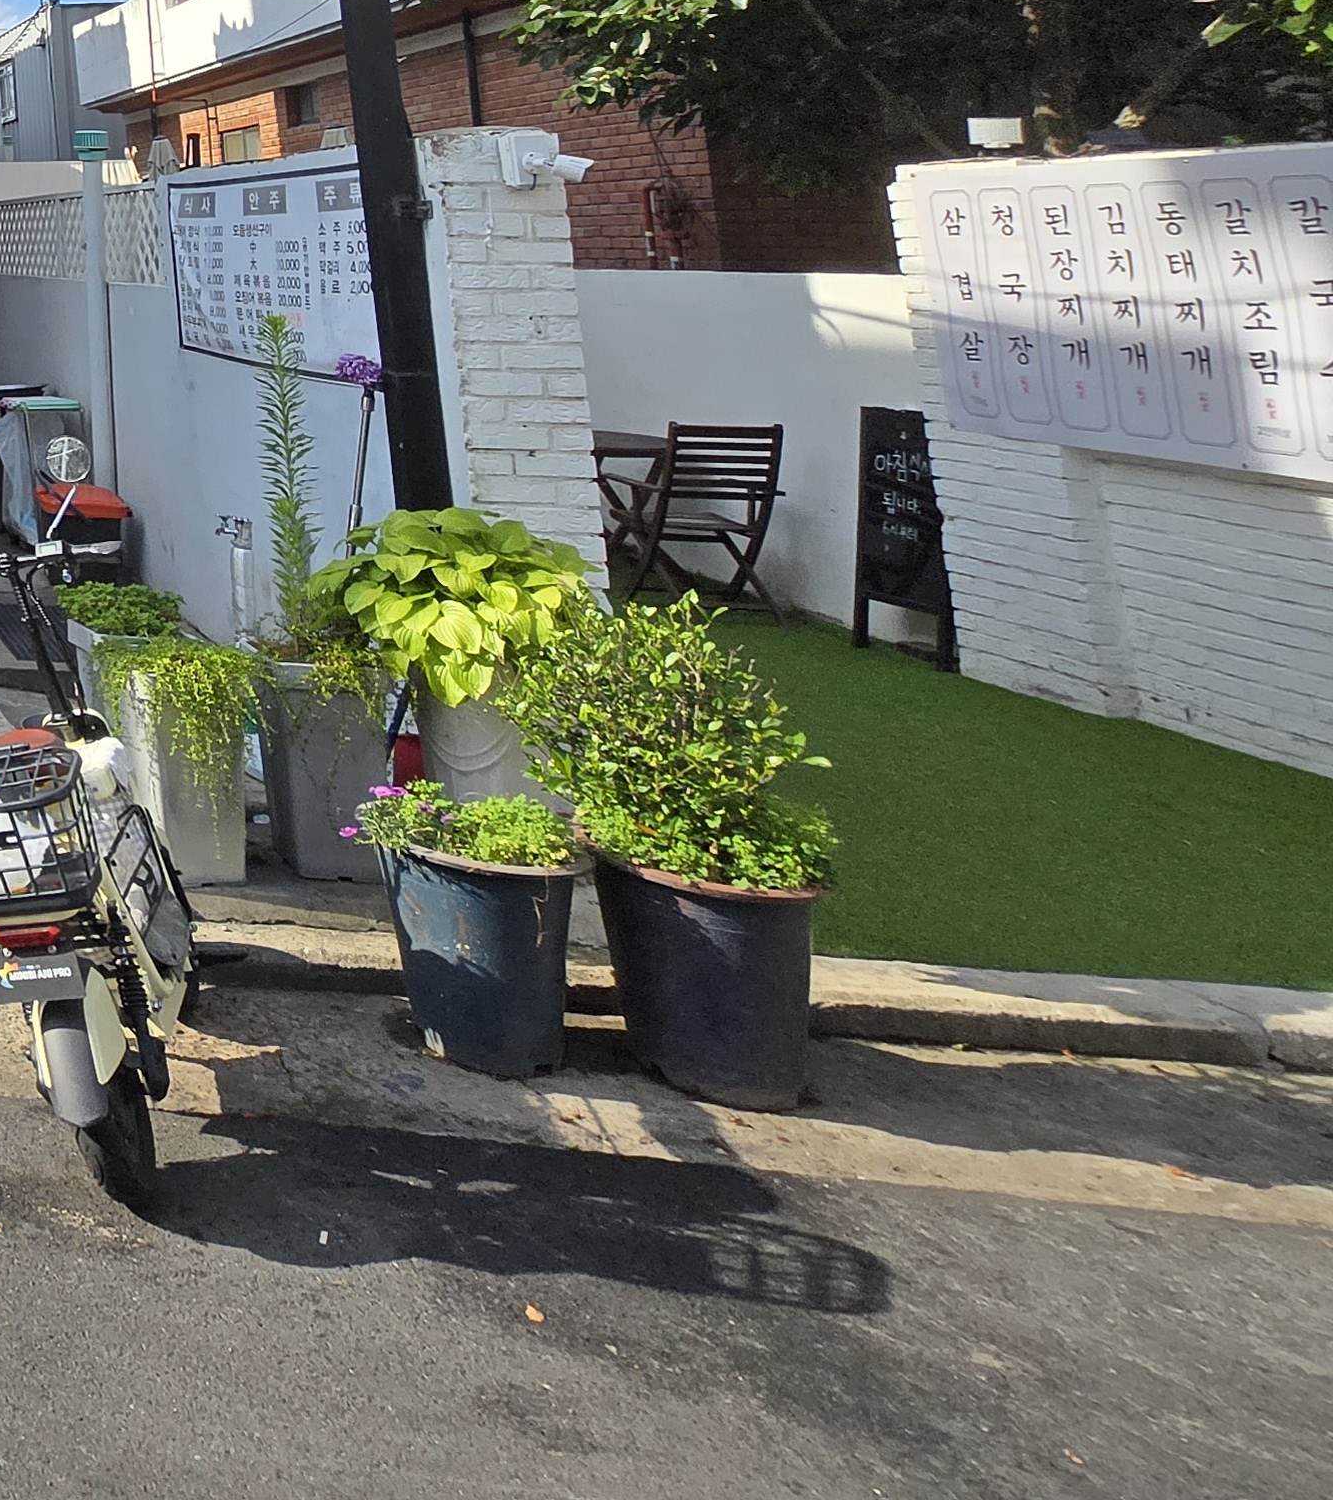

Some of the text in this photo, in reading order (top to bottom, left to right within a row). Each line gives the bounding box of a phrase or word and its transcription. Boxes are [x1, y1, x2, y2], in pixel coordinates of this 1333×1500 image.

[248, 190, 280, 210] 안주
[324, 182, 361, 206] 주류
[184, 196, 211, 214] 식사
[318, 221, 341, 236] 소주
[318, 241, 341, 256] 맥주
[250, 258, 258, 271] 大
[277, 276, 301, 290] 20,000
[940, 206, 984, 362] 삼겹살
[991, 205, 1034, 365] 청국장
[1044, 204, 1091, 370] 된장찌개
[1098, 202, 1148, 375] 김치찌개
[1156, 200, 1213, 380] 동태찌개
[1214, 198, 1279, 386] 갈치조림
[278, 294, 302, 308] 20,000
[53, 967, 72, 978] PRO
